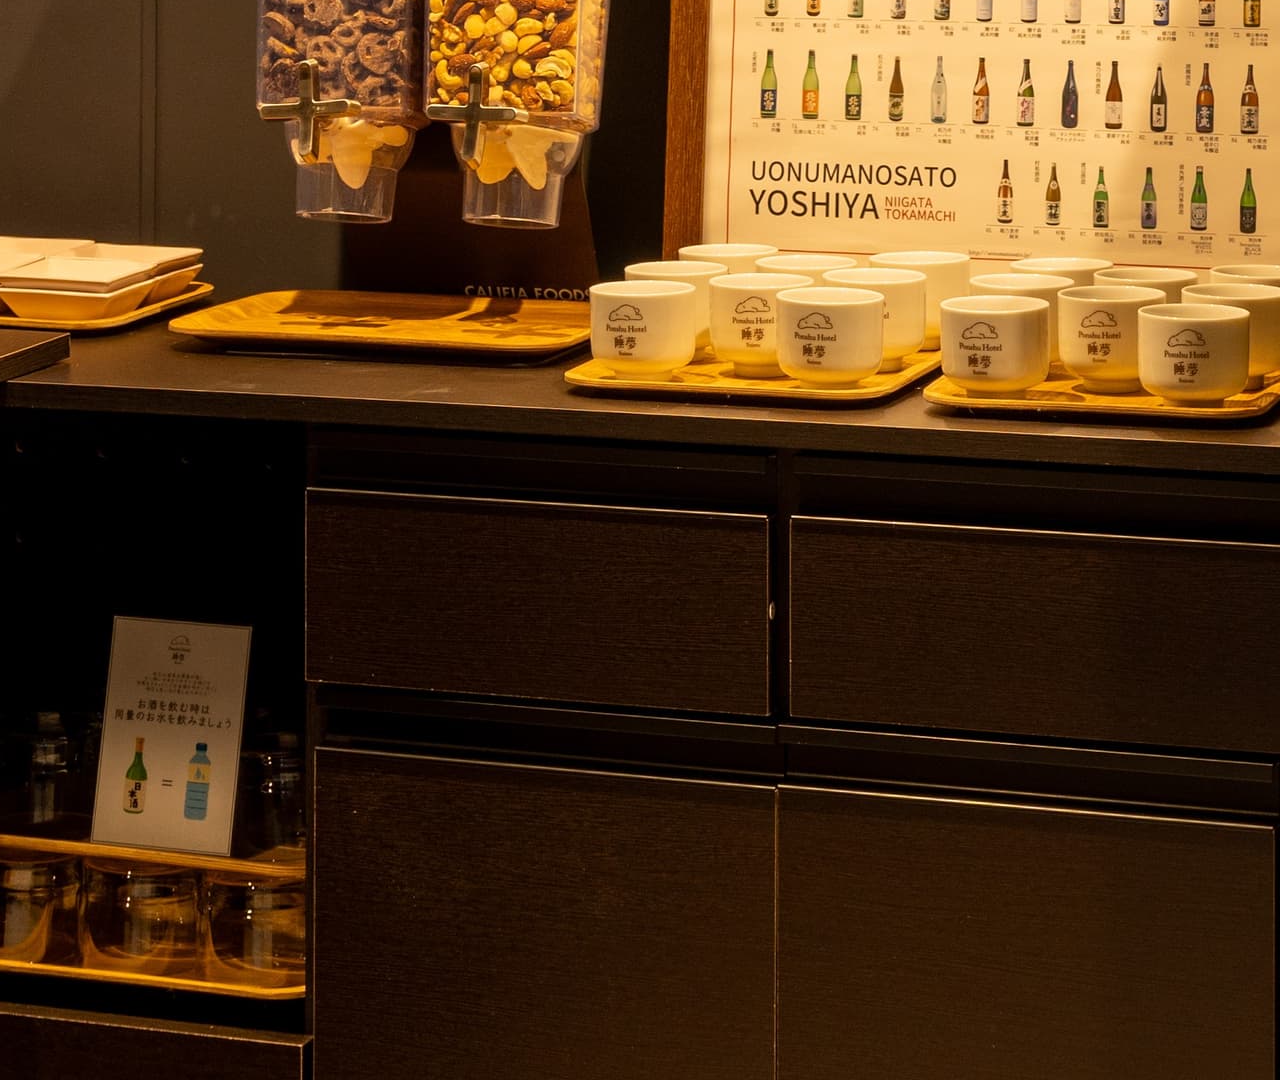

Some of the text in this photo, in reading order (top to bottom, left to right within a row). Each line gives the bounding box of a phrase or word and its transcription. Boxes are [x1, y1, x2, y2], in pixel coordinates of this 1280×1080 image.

[751, 160, 958, 188] UONUMANOSATO
[749, 188, 880, 220] YOSHIYA
[884, 196, 934, 209] NIIGATA
[884, 208, 957, 223] TOKAMACHI
[732, 316, 775, 325] Ponshu Hotel
[606, 323, 647, 334] Ponshu Hotel
[1077, 330, 1122, 340] Ponshu Hotel
[794, 331, 837, 342] Ponshu Hotel
[959, 341, 1003, 352] Ponshu Hotel
[1163, 350, 1210, 360] Ponshu Hotel
[138, 698, 211, 714] お酒を飲む時は
[115, 708, 233, 730] 同量のお水を飲みましょう
[128, 782, 142, 809] 日本酒
